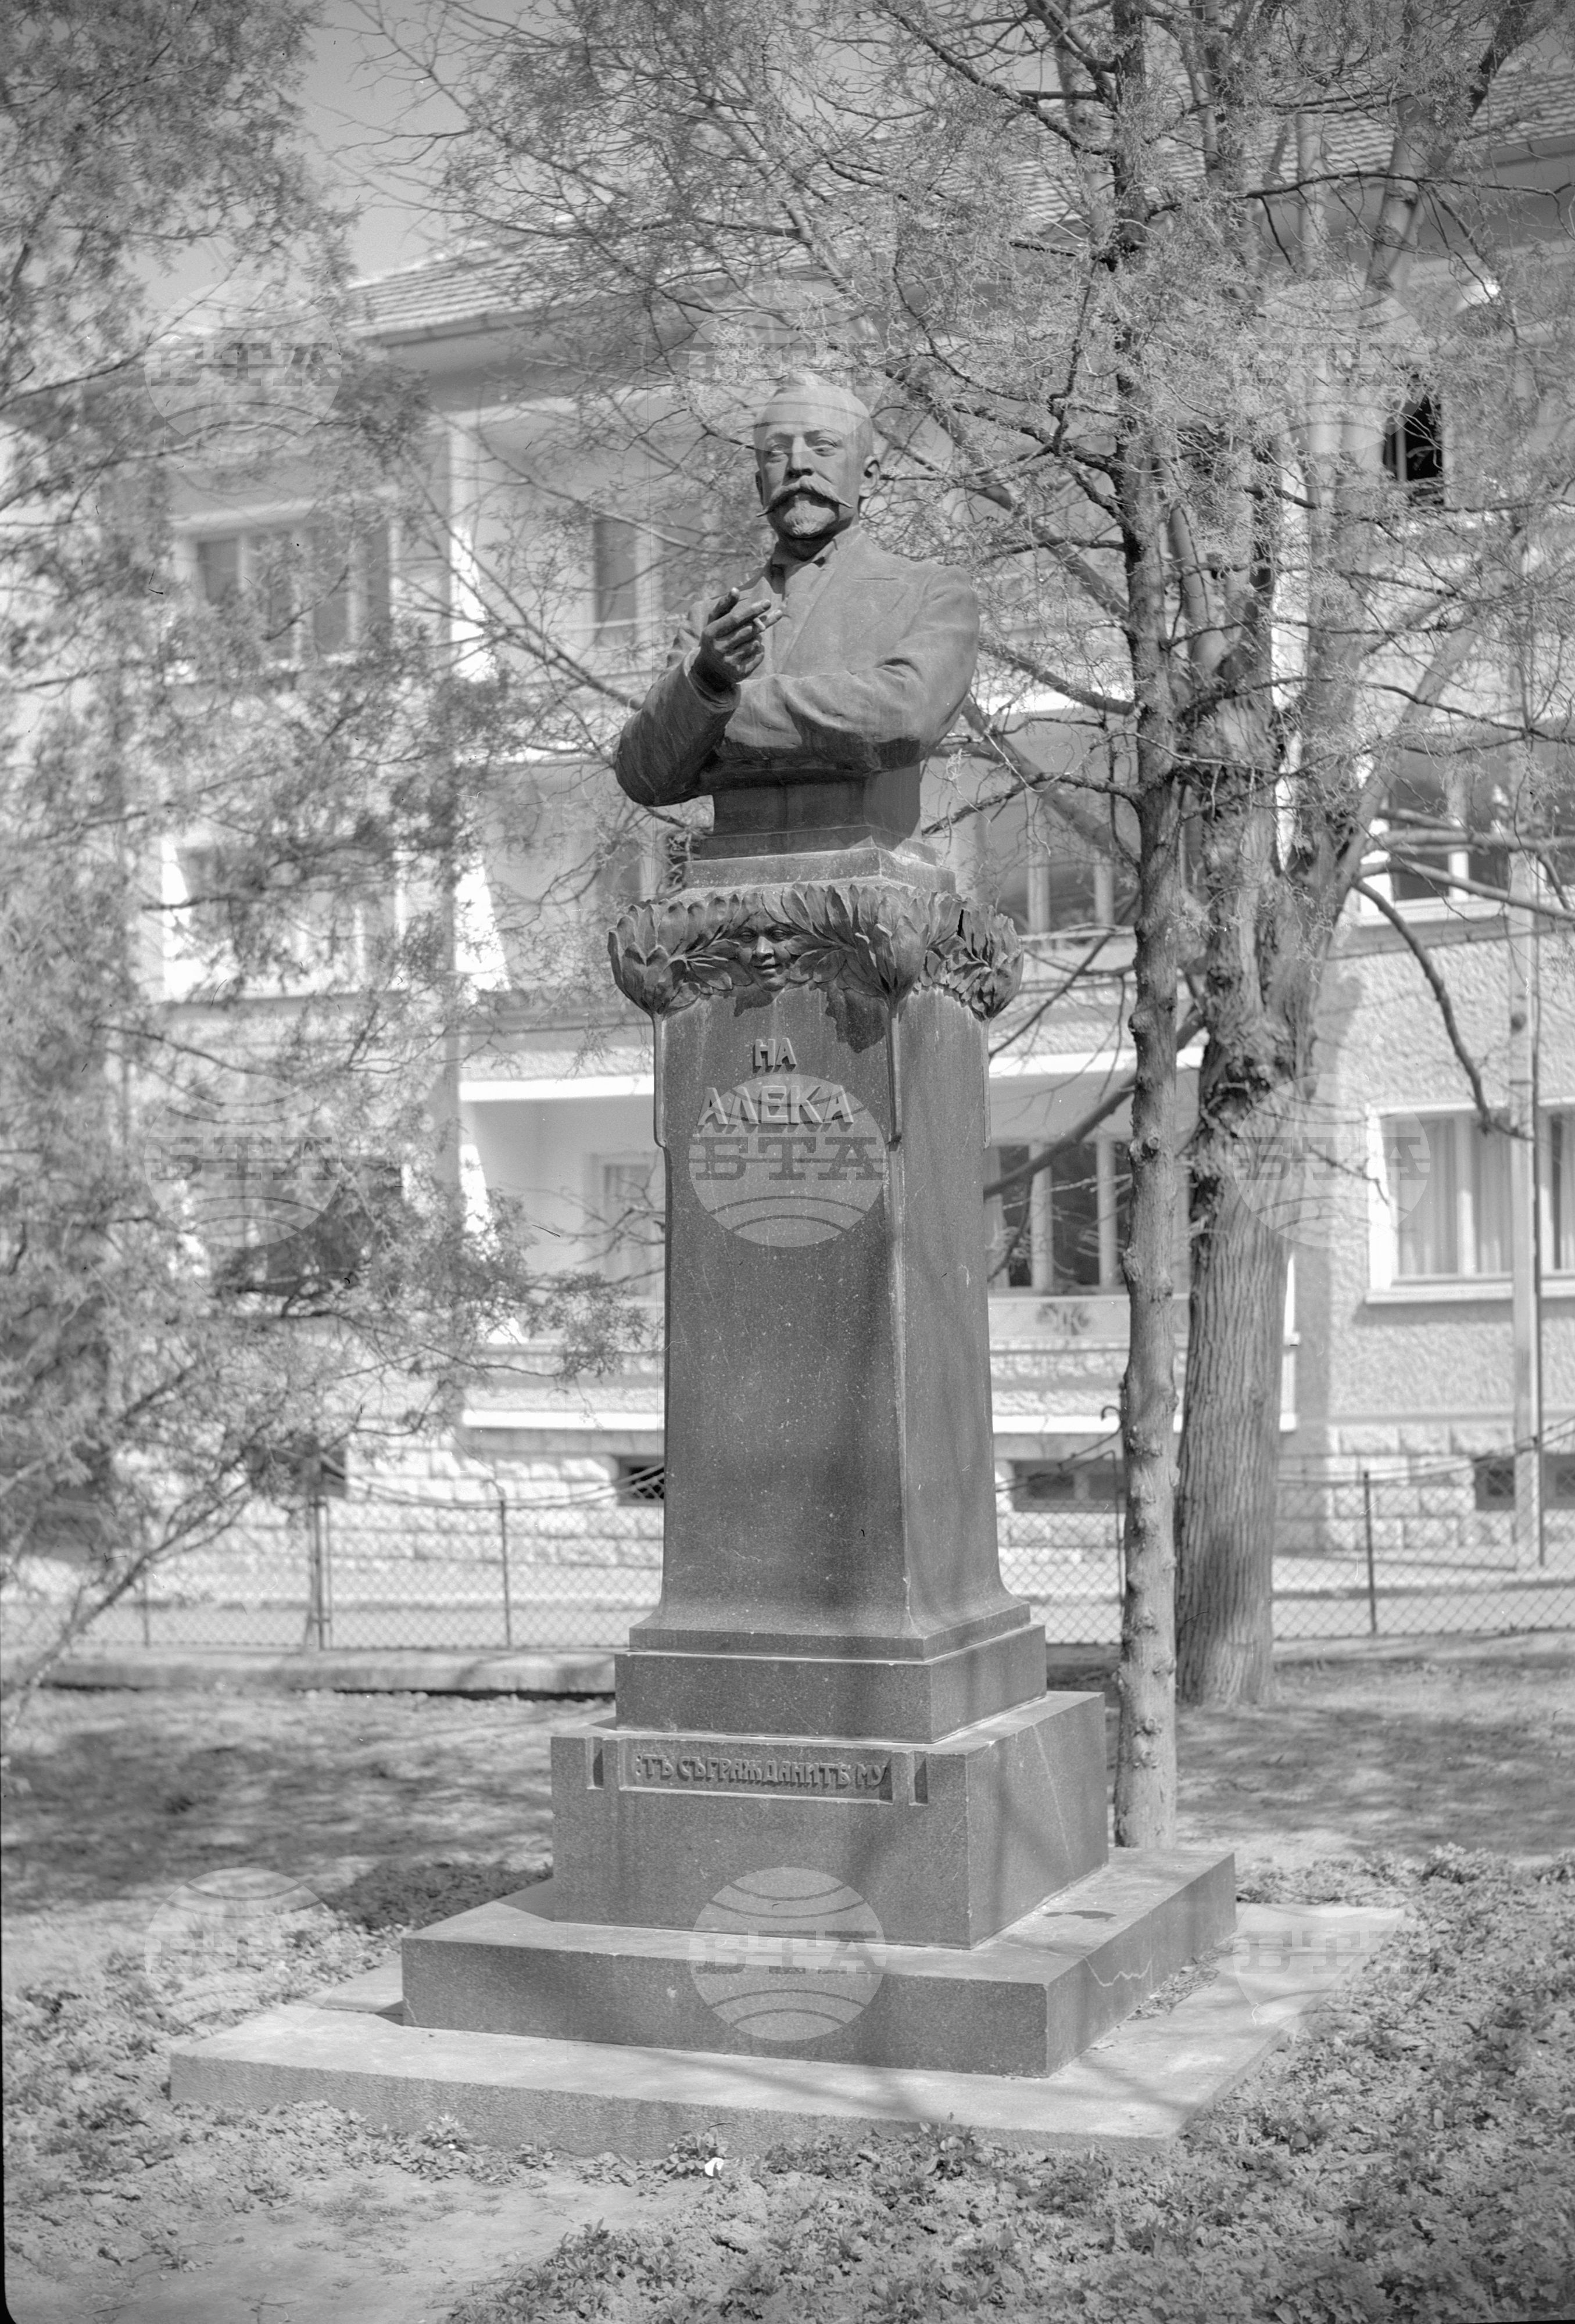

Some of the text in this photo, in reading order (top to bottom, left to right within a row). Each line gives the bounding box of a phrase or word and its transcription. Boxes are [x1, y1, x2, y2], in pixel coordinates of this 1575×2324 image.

[754, 1038, 797, 1072] НА
[697, 1085, 854, 1132] АЛЕКА
[857, 1762, 887, 1788] МУ
